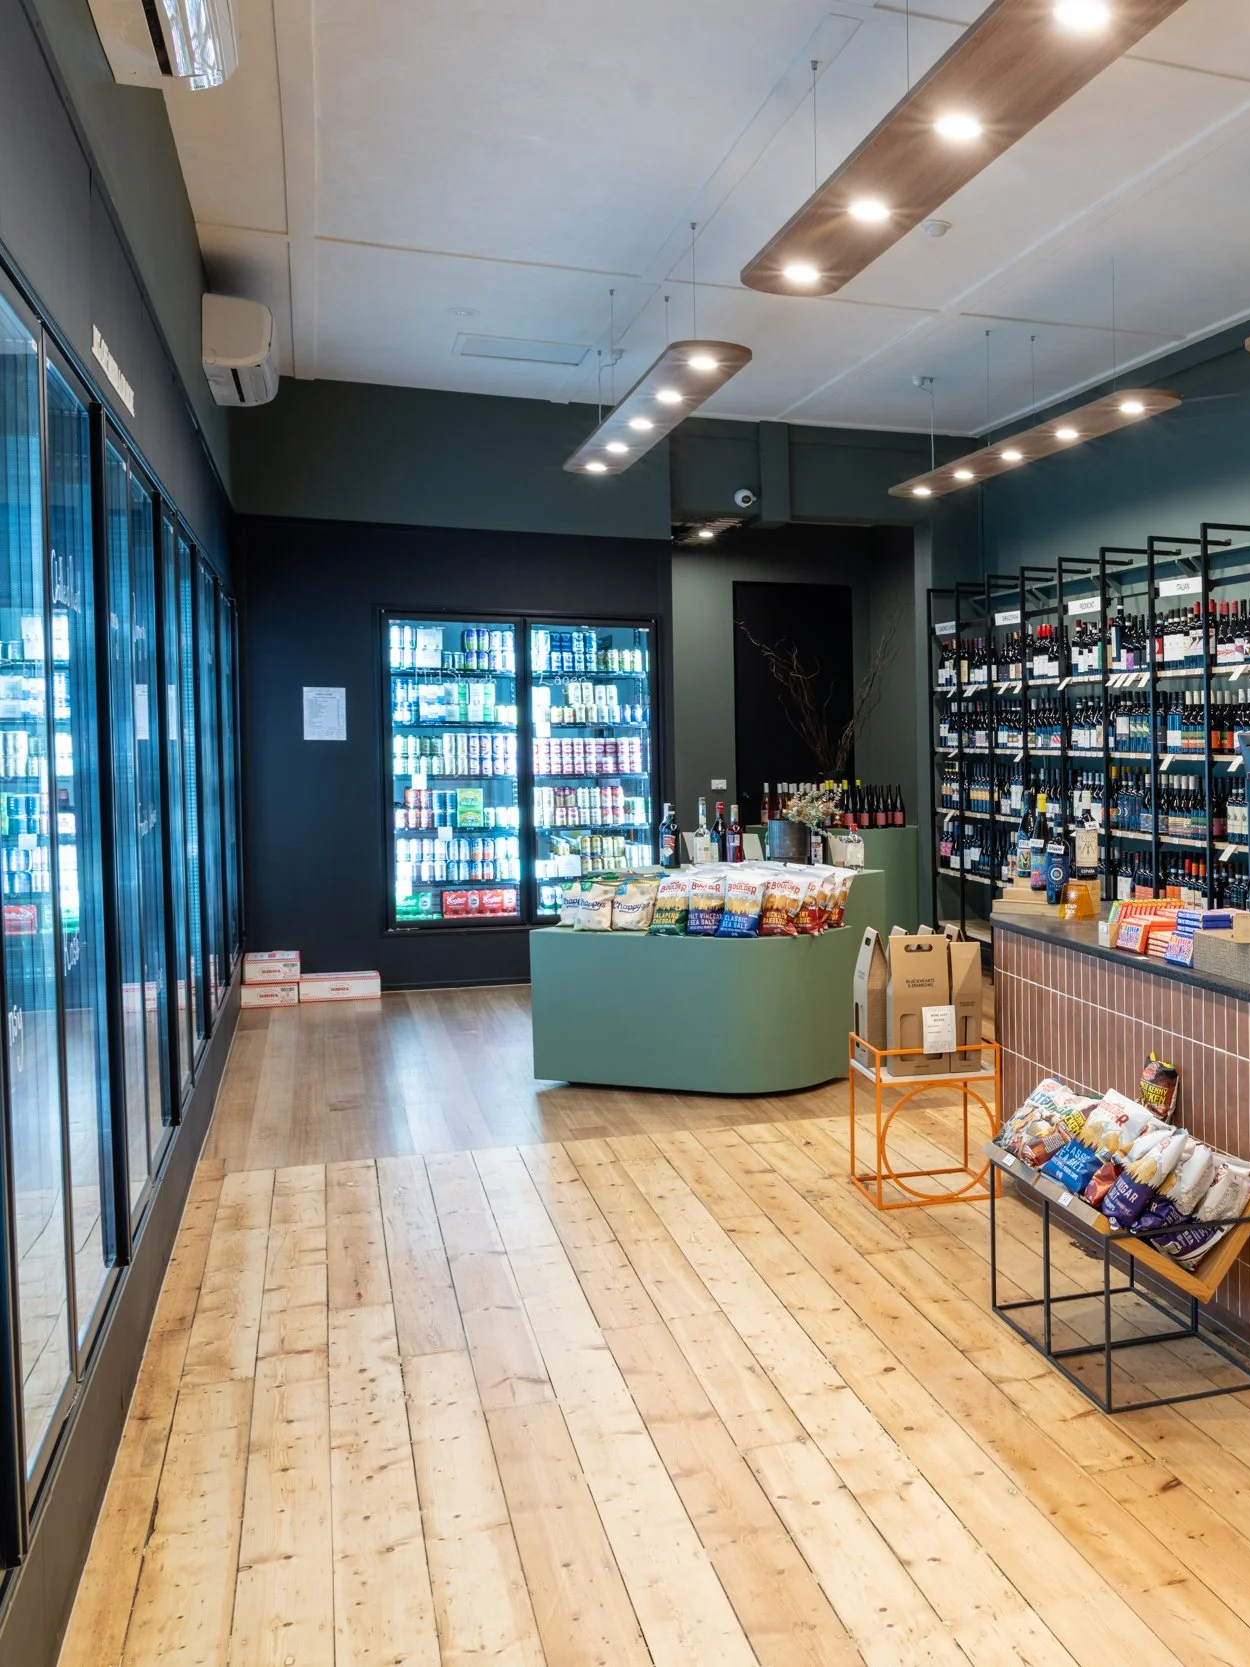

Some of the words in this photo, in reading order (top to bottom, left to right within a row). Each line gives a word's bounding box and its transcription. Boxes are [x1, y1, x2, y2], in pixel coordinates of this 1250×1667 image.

[660, 883, 687, 893] BOULDER
[728, 883, 757, 895] BOULDER
[770, 881, 800, 895] BOULDER
[724, 914, 748, 923] CLASSIC
[1148, 1084, 1168, 1096] KENNY
